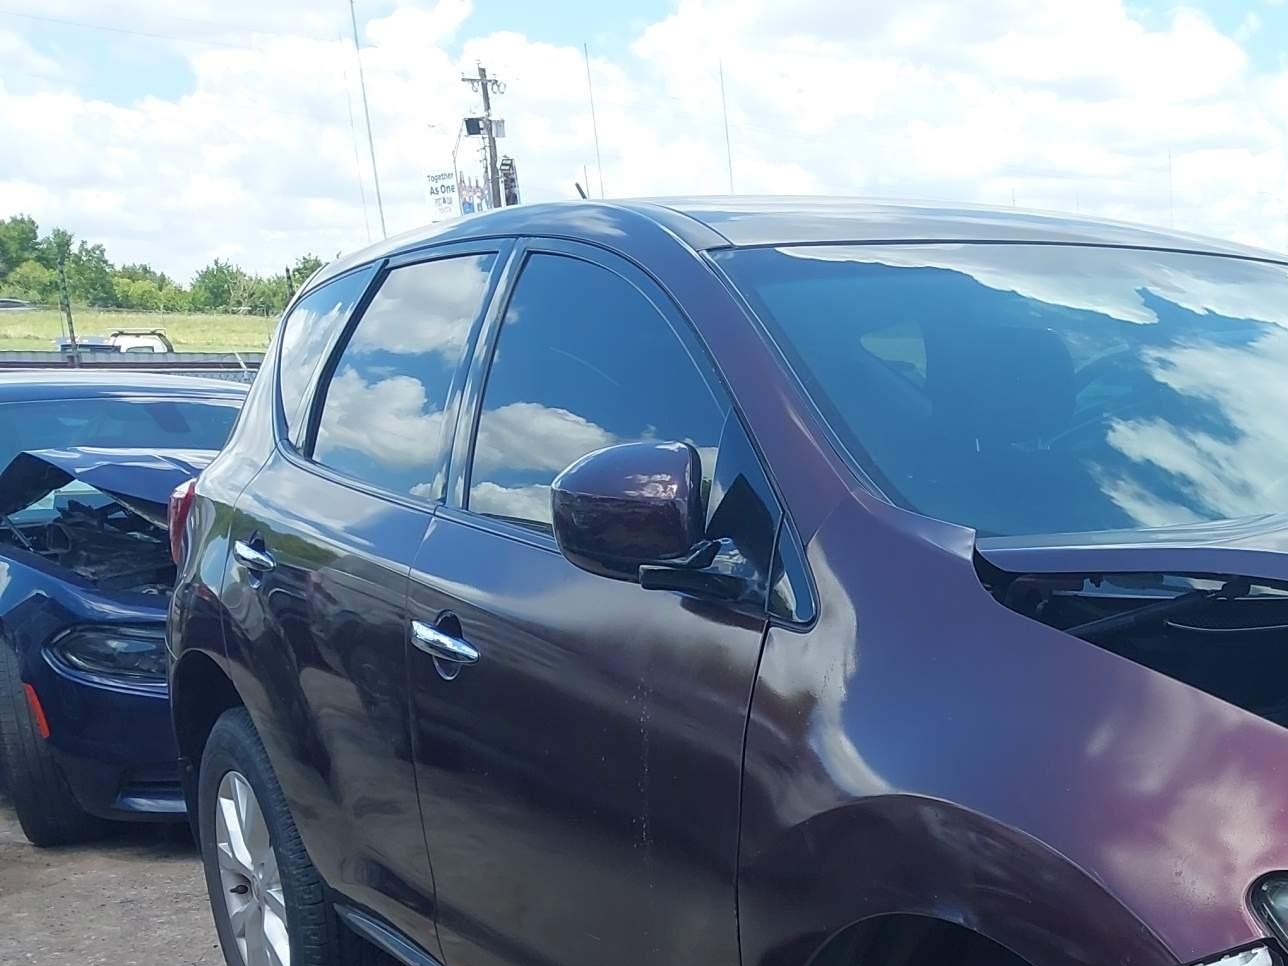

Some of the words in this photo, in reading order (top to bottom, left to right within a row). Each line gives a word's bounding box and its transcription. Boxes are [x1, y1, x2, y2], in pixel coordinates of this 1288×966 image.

[427, 172, 454, 183] Together
[430, 186, 439, 195] As
[440, 184, 456, 194] One
